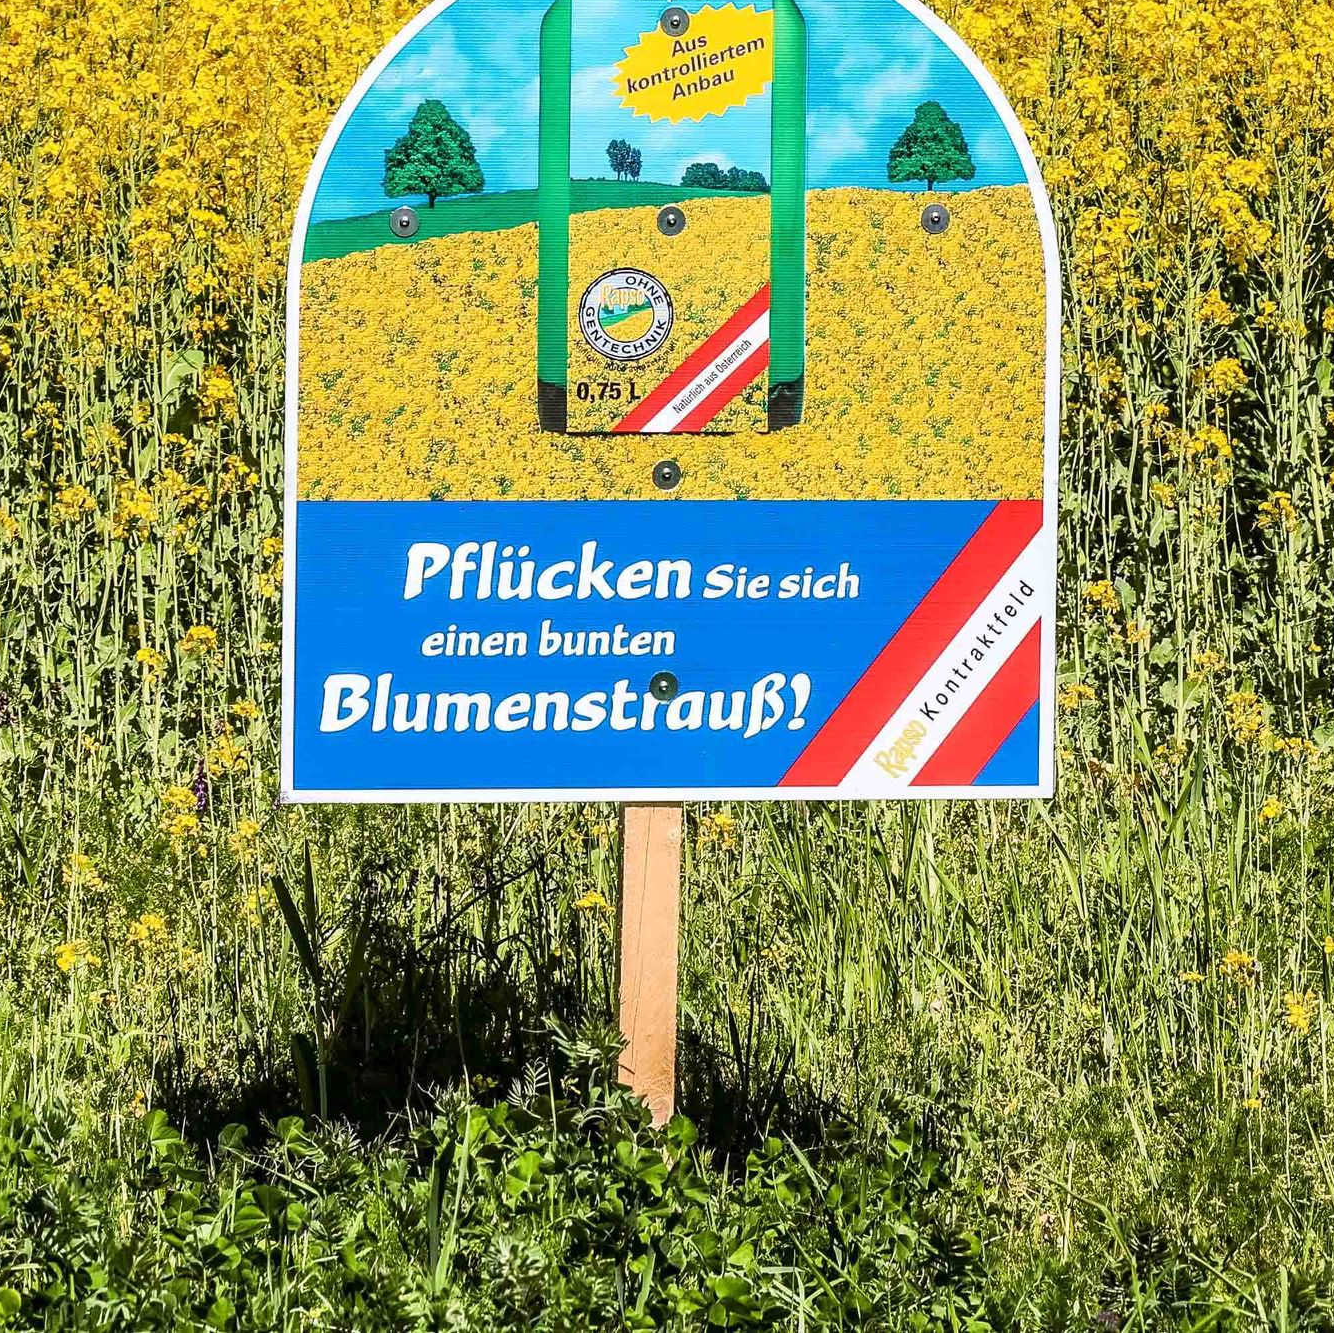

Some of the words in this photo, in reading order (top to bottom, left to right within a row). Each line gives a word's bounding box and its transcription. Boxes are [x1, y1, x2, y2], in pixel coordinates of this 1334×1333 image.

[627, 36, 765, 94] kontrolliertem
[671, 35, 707, 57] Aus
[671, 68, 735, 101] Anbau
[625, 276, 664, 306] OHNE
[585, 306, 667, 354] GENTECHNIK
[576, 382, 621, 403] 0,75
[672, 382, 706, 414] Natürlich
[703, 371, 719, 386] aus
[715, 339, 752, 374] Österreich
[402, 540, 692, 601] Pflücken
[702, 563, 770, 600] Sie
[777, 562, 860, 599] sich
[421, 624, 527, 657] einen
[538, 619, 676, 657] bunten
[873, 720, 927, 779] Rapso
[919, 579, 1035, 721] Kontraktfeld
[318, 672, 812, 739] Blumenstrauß!
